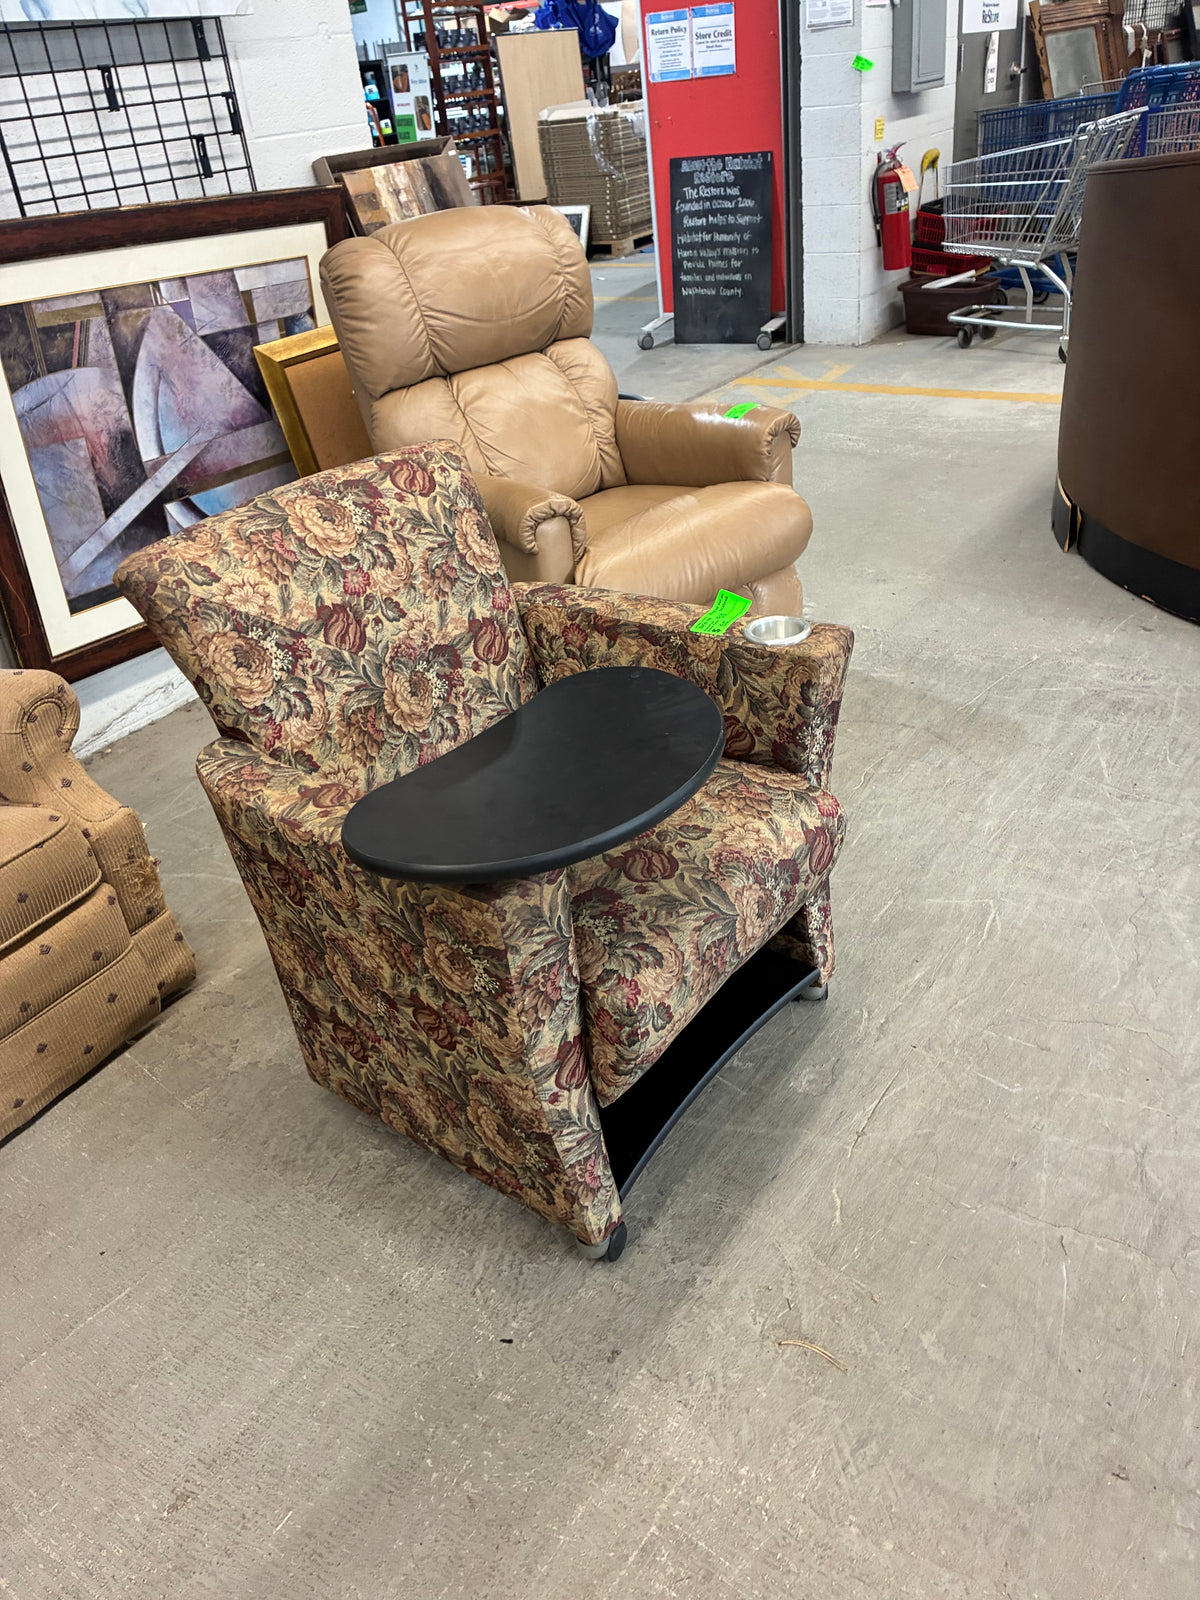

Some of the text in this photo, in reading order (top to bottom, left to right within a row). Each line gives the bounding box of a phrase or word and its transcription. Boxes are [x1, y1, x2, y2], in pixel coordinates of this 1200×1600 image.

[651, 25, 687, 36] Return Policy
[695, 29, 732, 40] Store Credit
[683, 187, 698, 200] The
[726, 185, 740, 196] was
[675, 199, 703, 214] founded
[703, 199, 711, 209] in
[708, 212, 728, 226] helps
[728, 213, 735, 224] to
[702, 230, 712, 242] for
[730, 258, 743, 269] for
